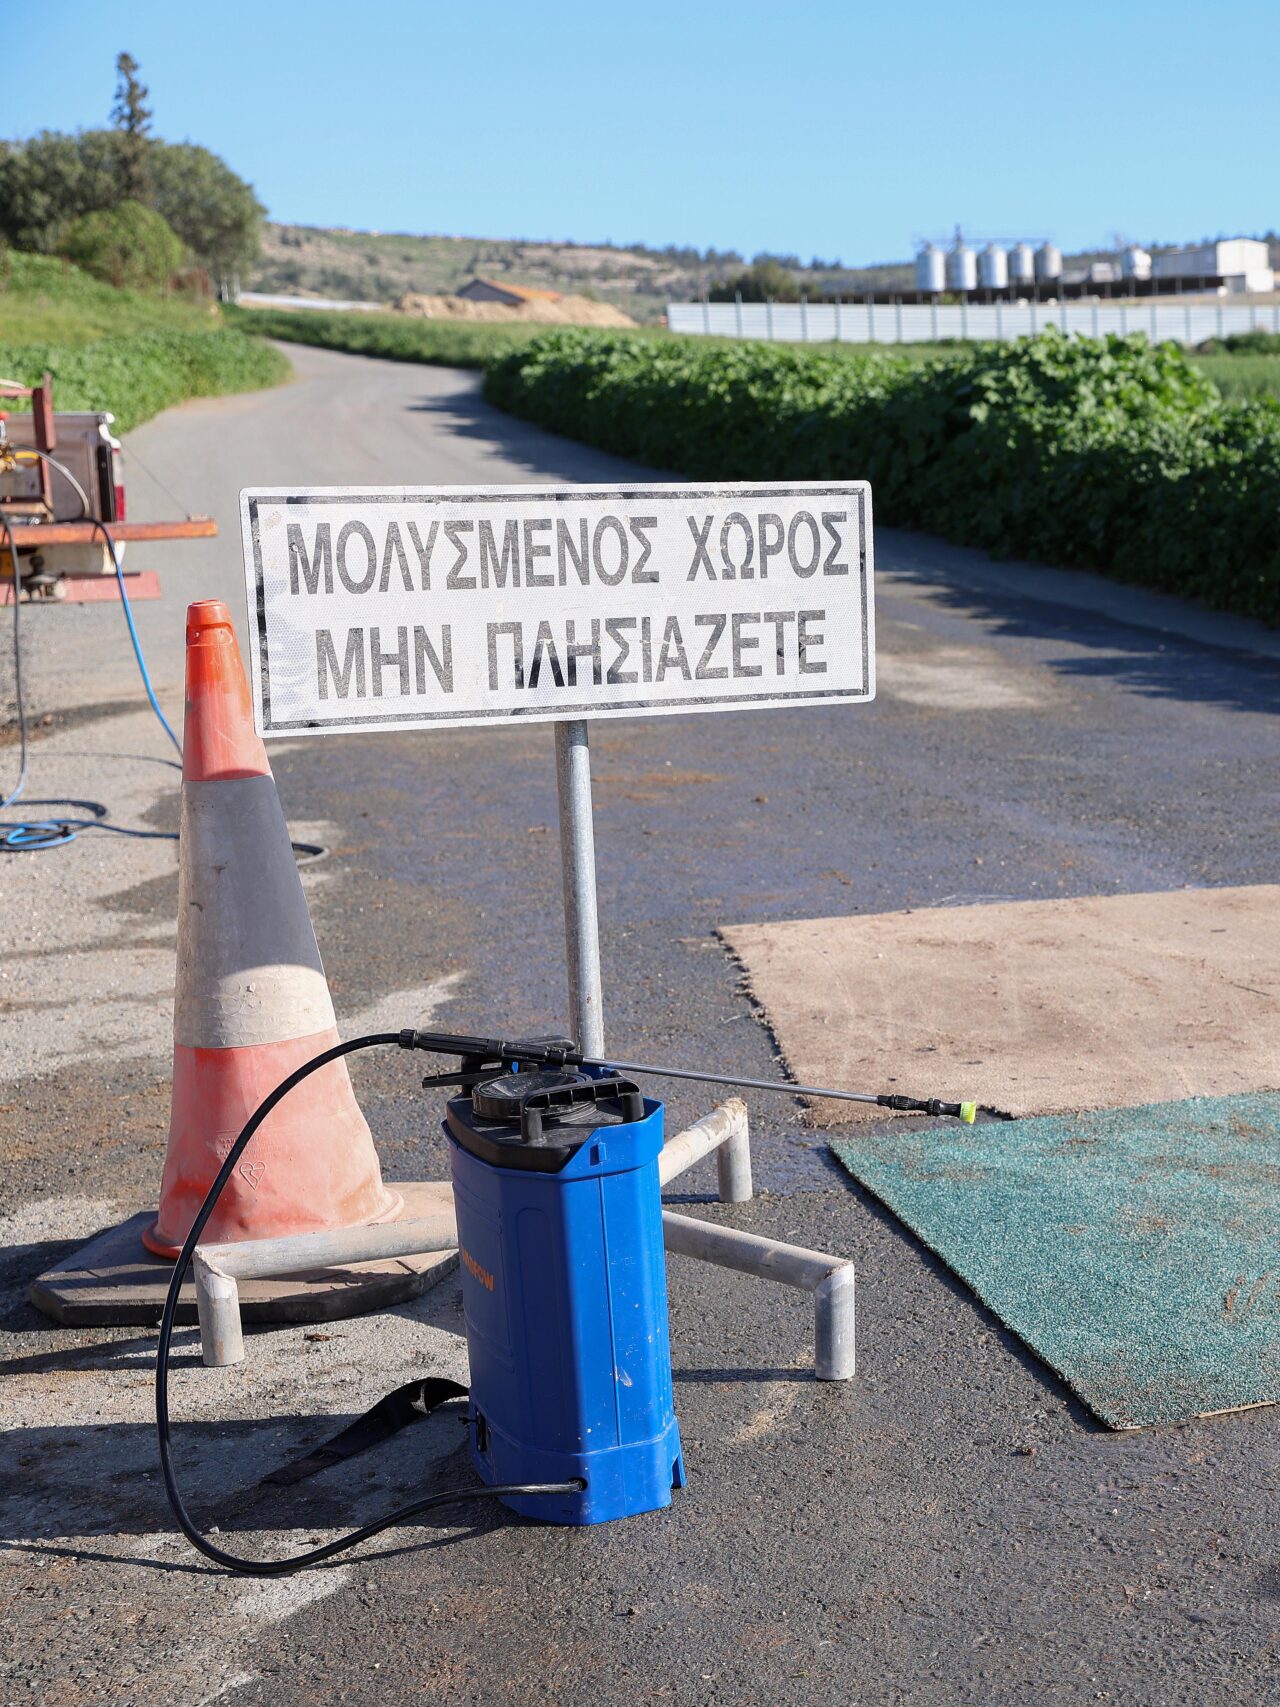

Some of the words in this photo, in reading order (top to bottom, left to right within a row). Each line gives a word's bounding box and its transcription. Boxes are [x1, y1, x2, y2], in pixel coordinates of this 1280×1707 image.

[286, 516, 661, 596] ΜΟΛΥΣΜΕΝΟΣ
[687, 511, 850, 582] ΧΩΡΟΣ
[315, 624, 454, 701] ΜΗΝ
[486, 609, 828, 691] ΠΛΗΣΙΑΖΕΤΕ
